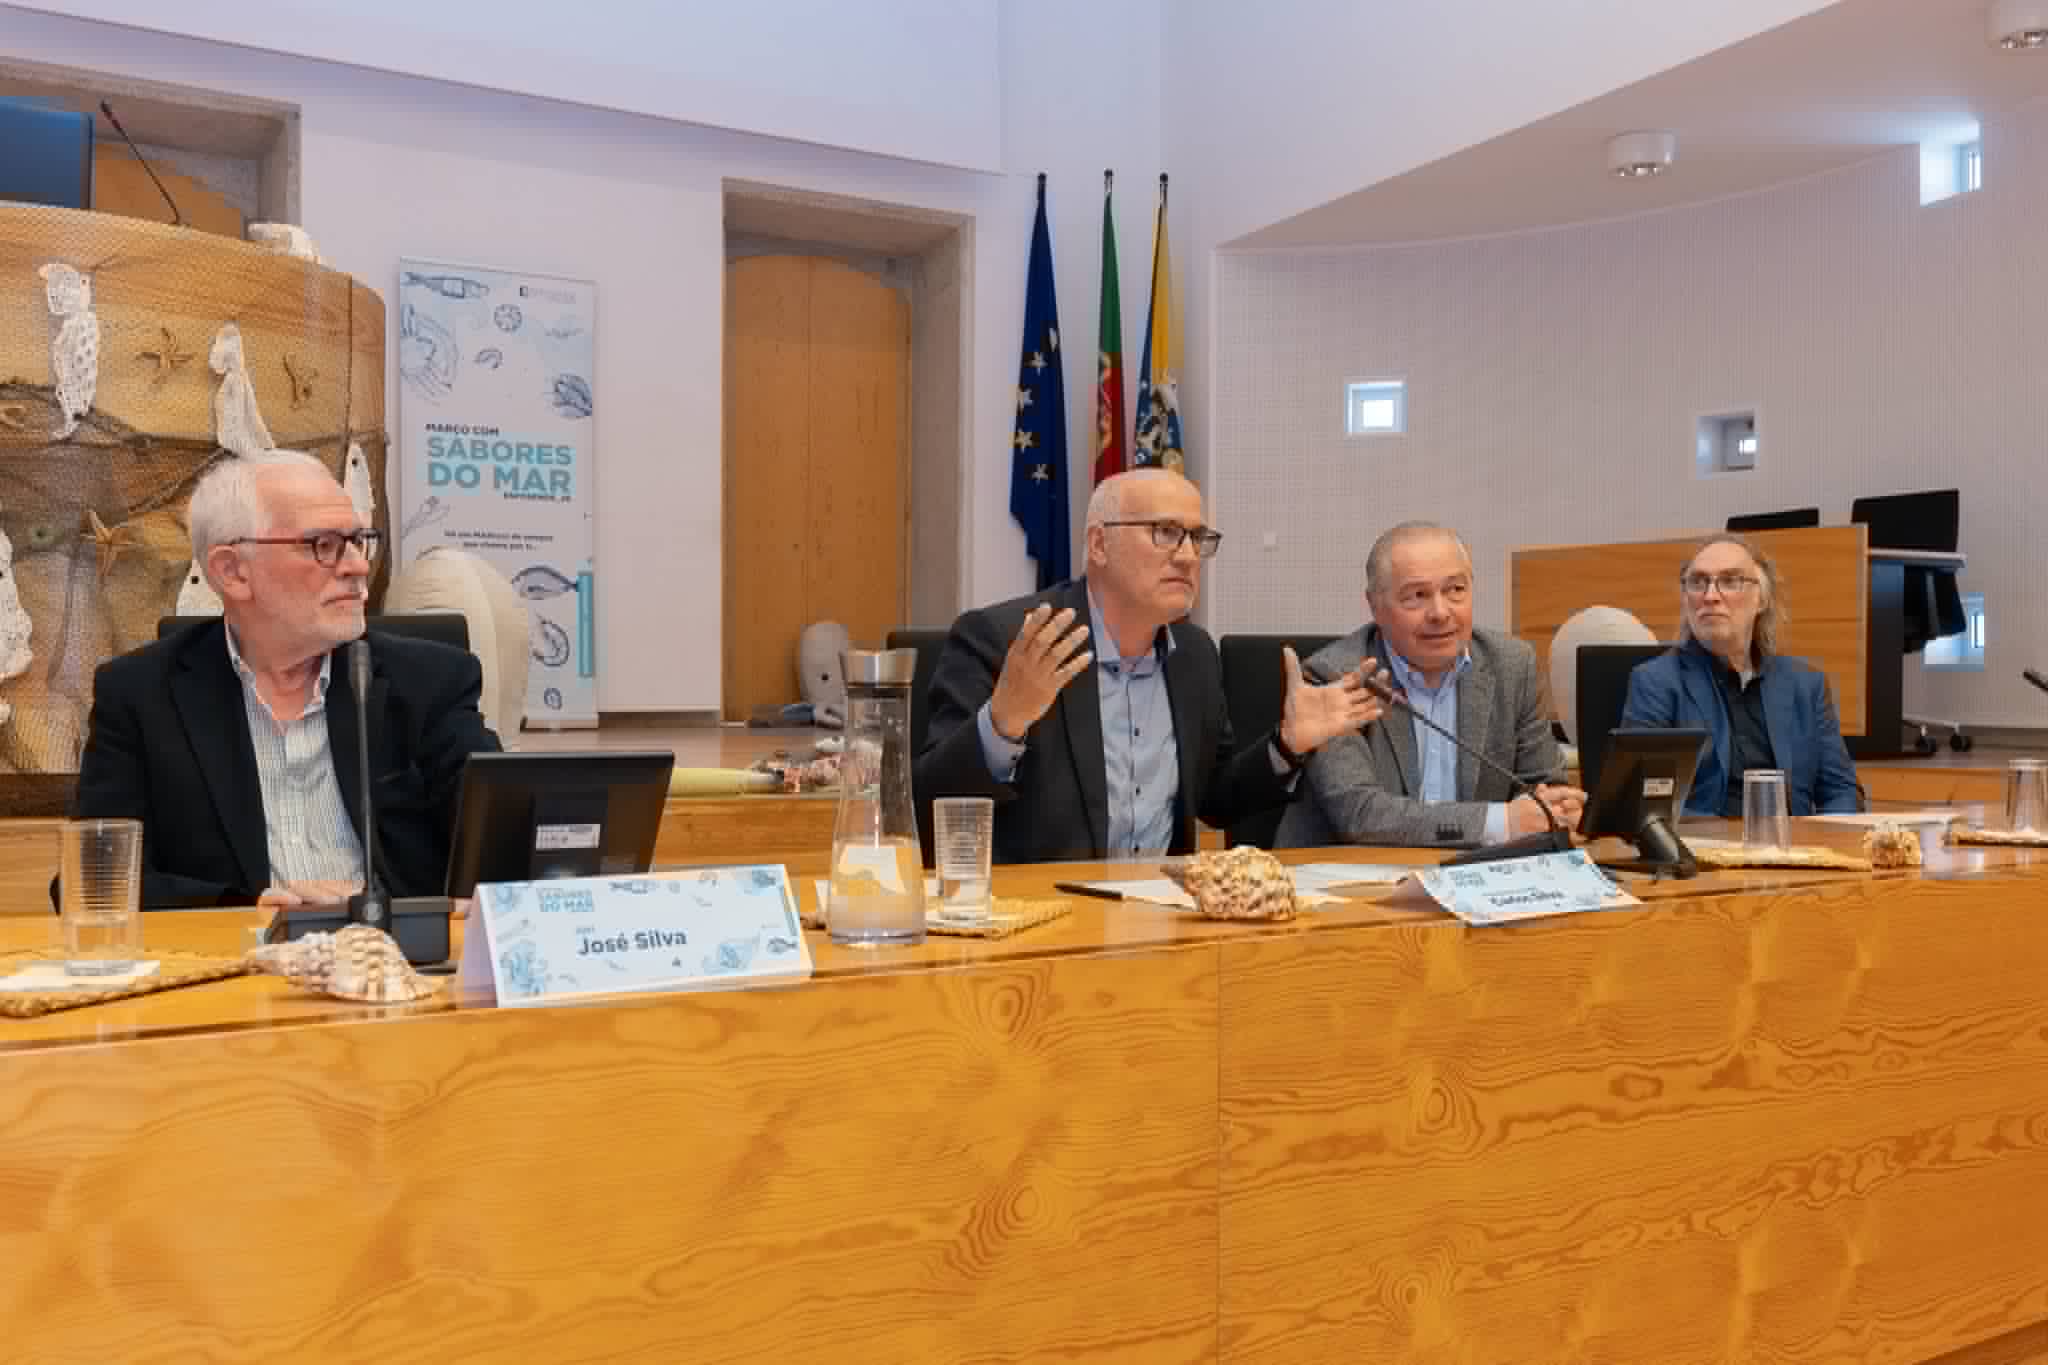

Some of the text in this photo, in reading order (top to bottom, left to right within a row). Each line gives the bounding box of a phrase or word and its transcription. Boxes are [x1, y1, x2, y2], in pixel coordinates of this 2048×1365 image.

[427, 436, 572, 465] SABORES
[427, 462, 571, 492] DO MAR
[577, 928, 687, 955] José Silva
